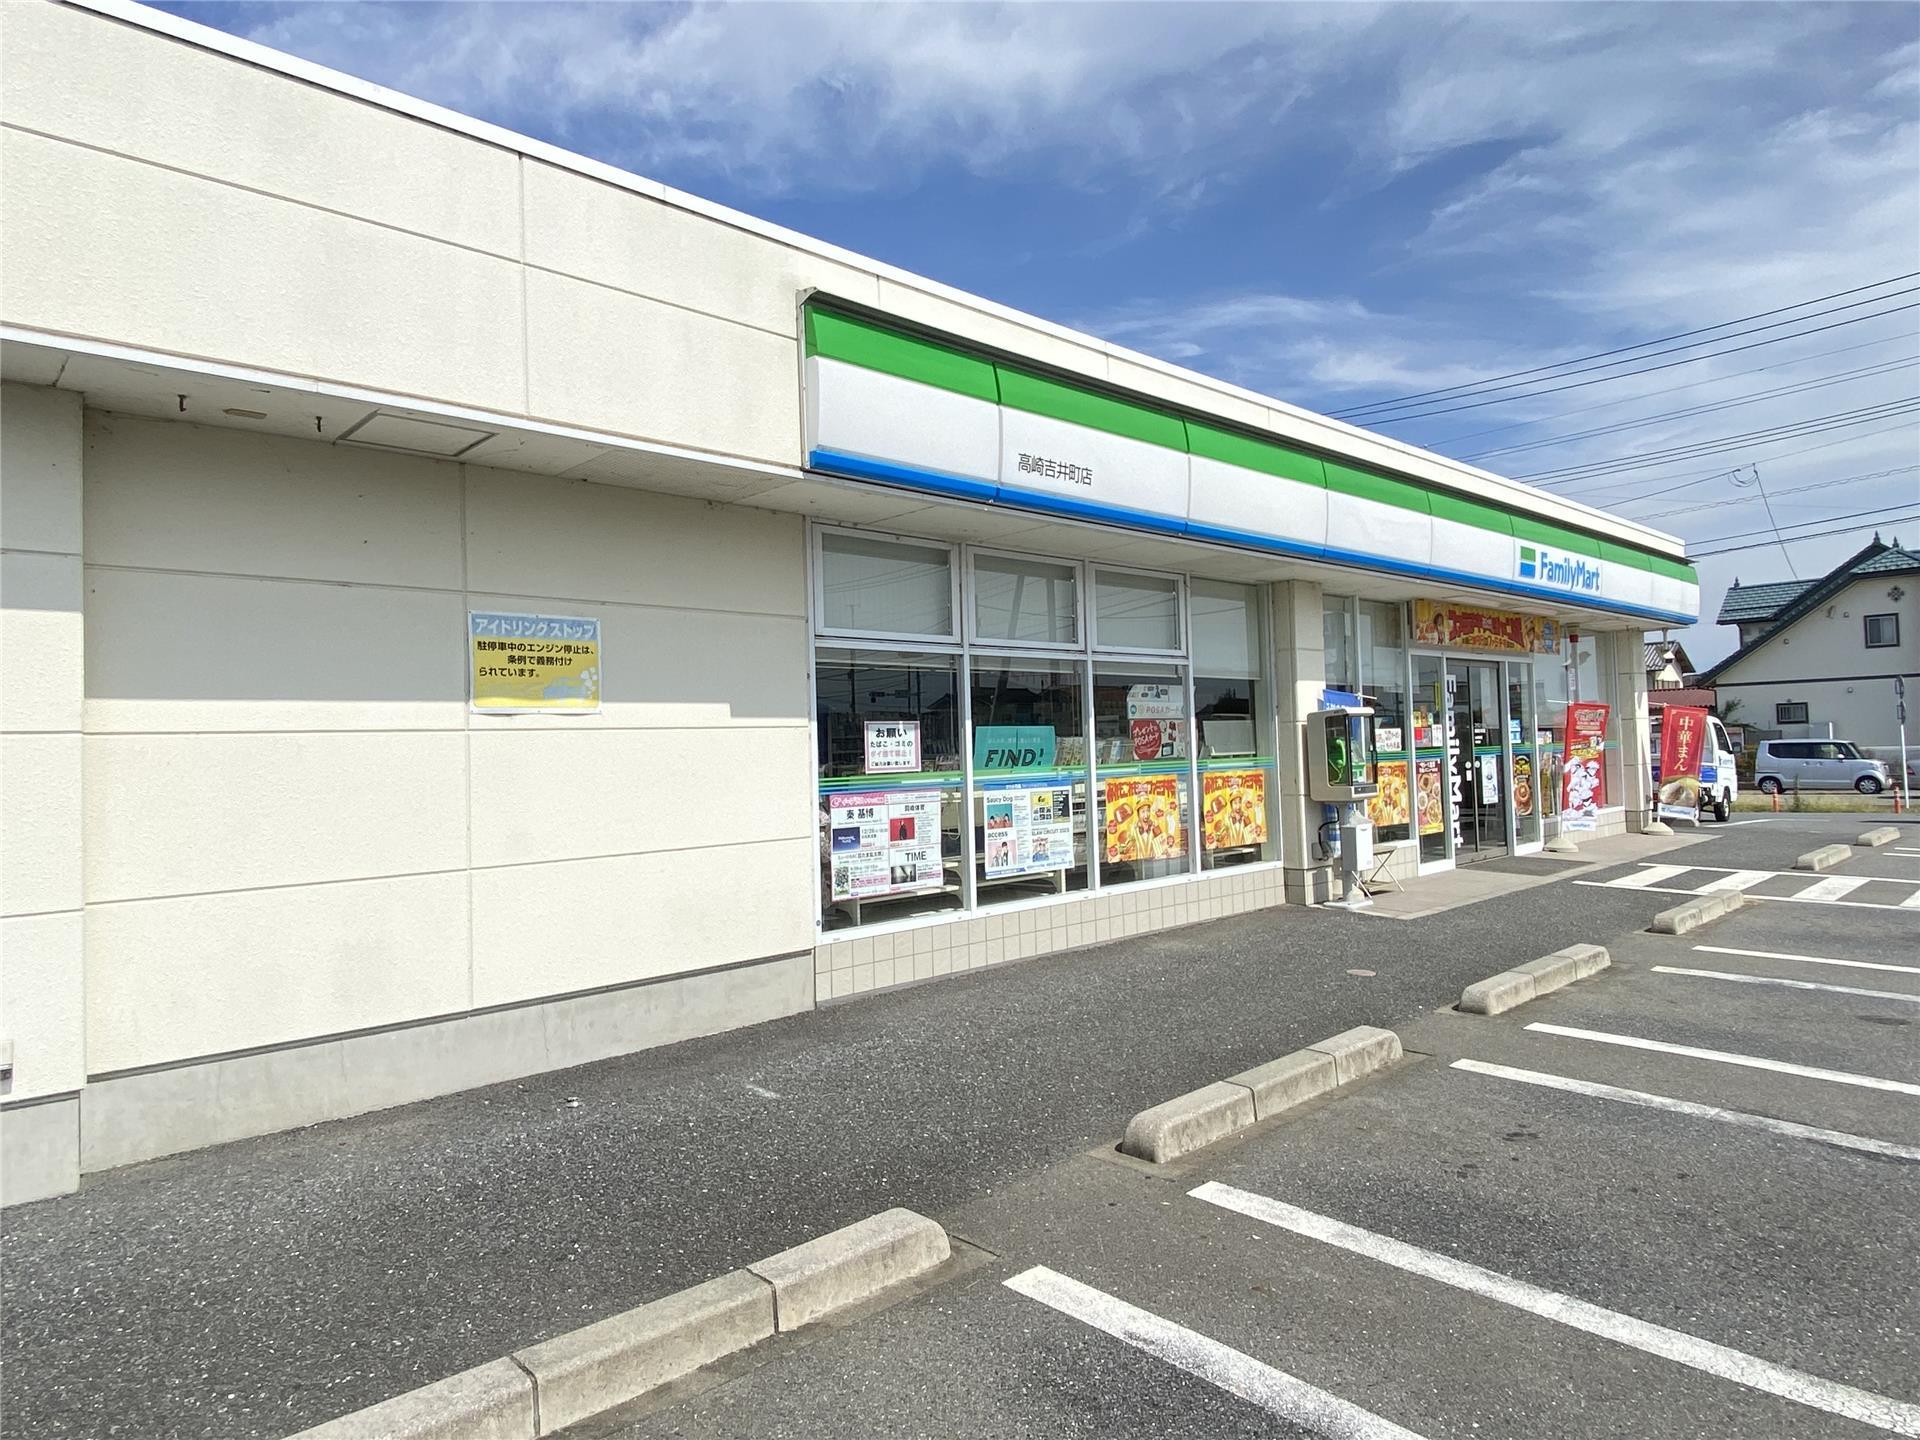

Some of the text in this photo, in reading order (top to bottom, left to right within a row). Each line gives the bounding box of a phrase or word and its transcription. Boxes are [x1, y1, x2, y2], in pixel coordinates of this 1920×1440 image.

[1018, 453, 1093, 486] 高崎吉井町店
[1540, 551, 1600, 592] FamilyMart
[475, 618, 595, 638] アイドリングストップ
[477, 641, 594, 655] 駐停車中のエンジン停止は、
[507, 655, 573, 666] 条例で義務付け
[479, 667, 540, 678] られています。
[876, 728, 907, 738] お願い
[1673, 716, 1694, 772] 中華まん
[984, 748, 1045, 768] FIND!
[1447, 674, 1464, 848] FamilyMart
[904, 851, 928, 862] TIME
